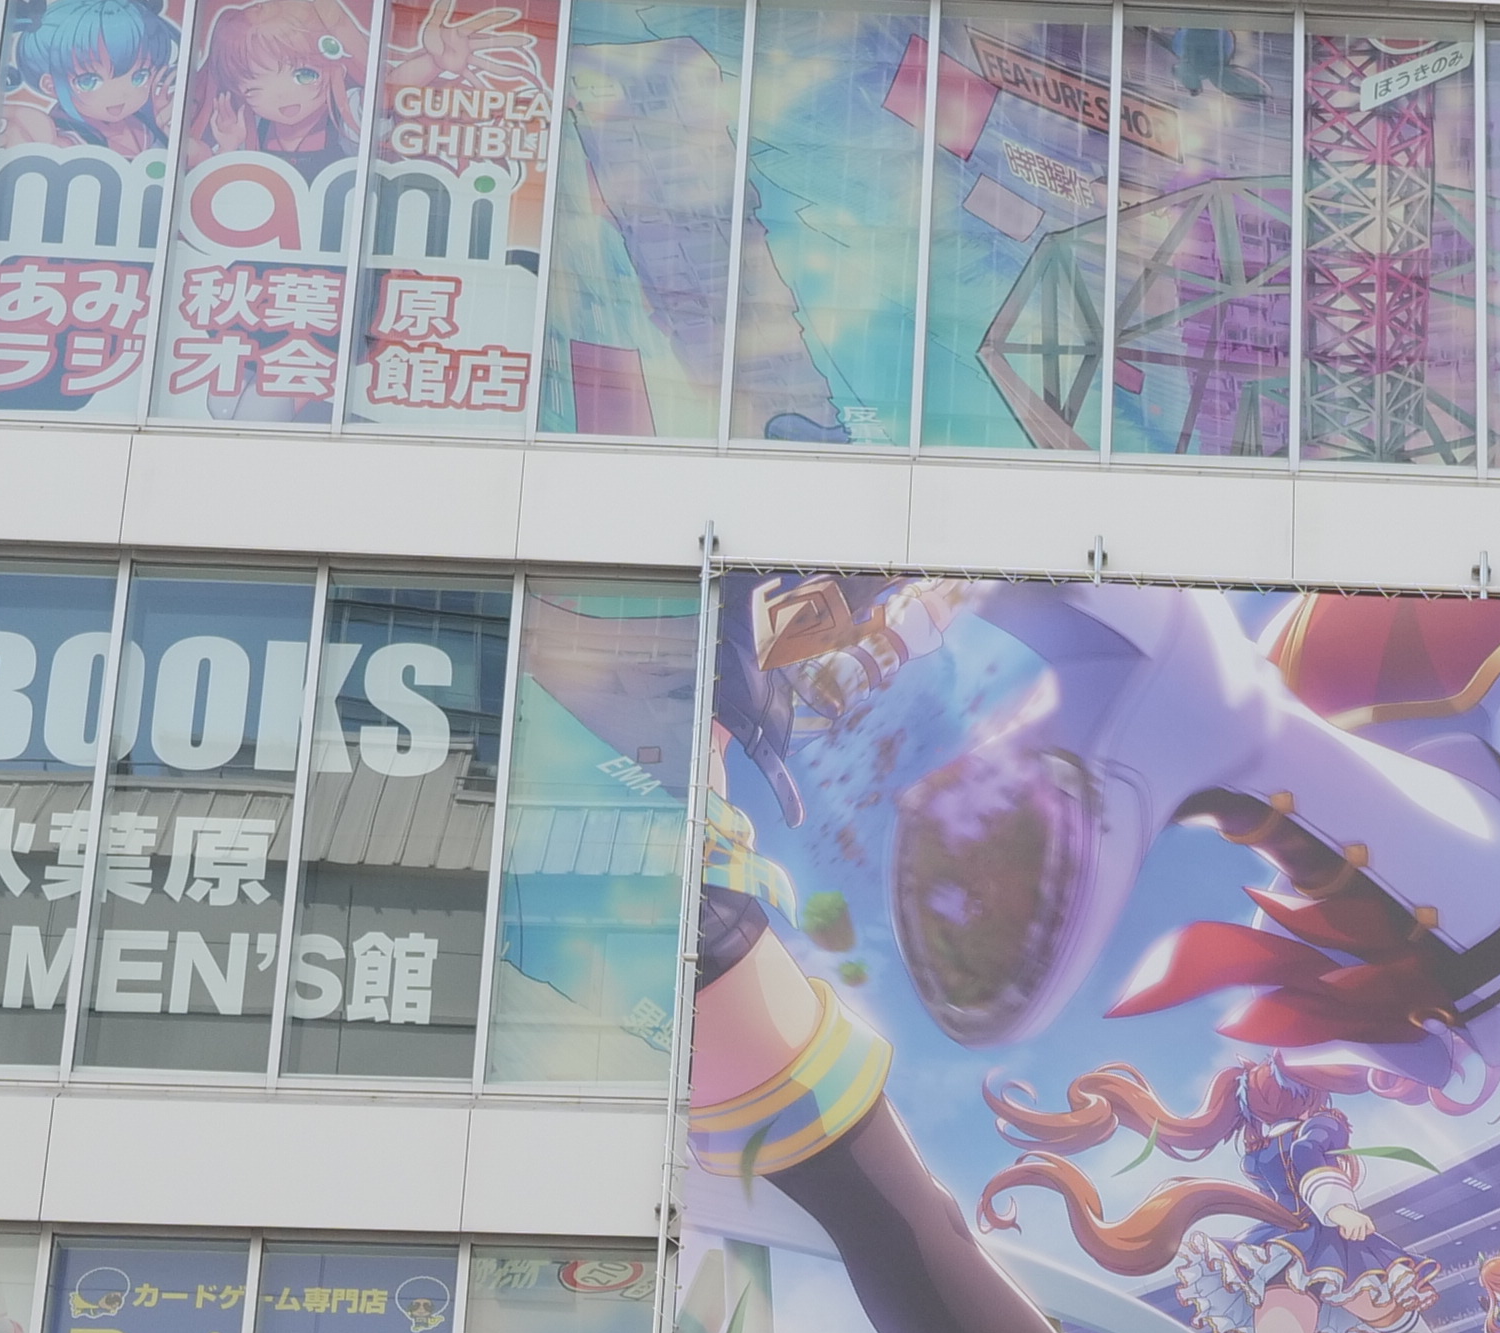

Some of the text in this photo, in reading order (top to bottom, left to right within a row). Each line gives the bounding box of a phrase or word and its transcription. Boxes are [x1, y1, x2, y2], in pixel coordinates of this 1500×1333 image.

[986, 50, 1096, 118] FEATURE
[1372, 46, 1464, 100] ほうきのみ
[393, 86, 552, 124] GUNPLA
[391, 121, 549, 162] GHIBLI
[186, 267, 461, 339] 秋葉原
[132, 1282, 389, 1315] カードゲーム専門店
